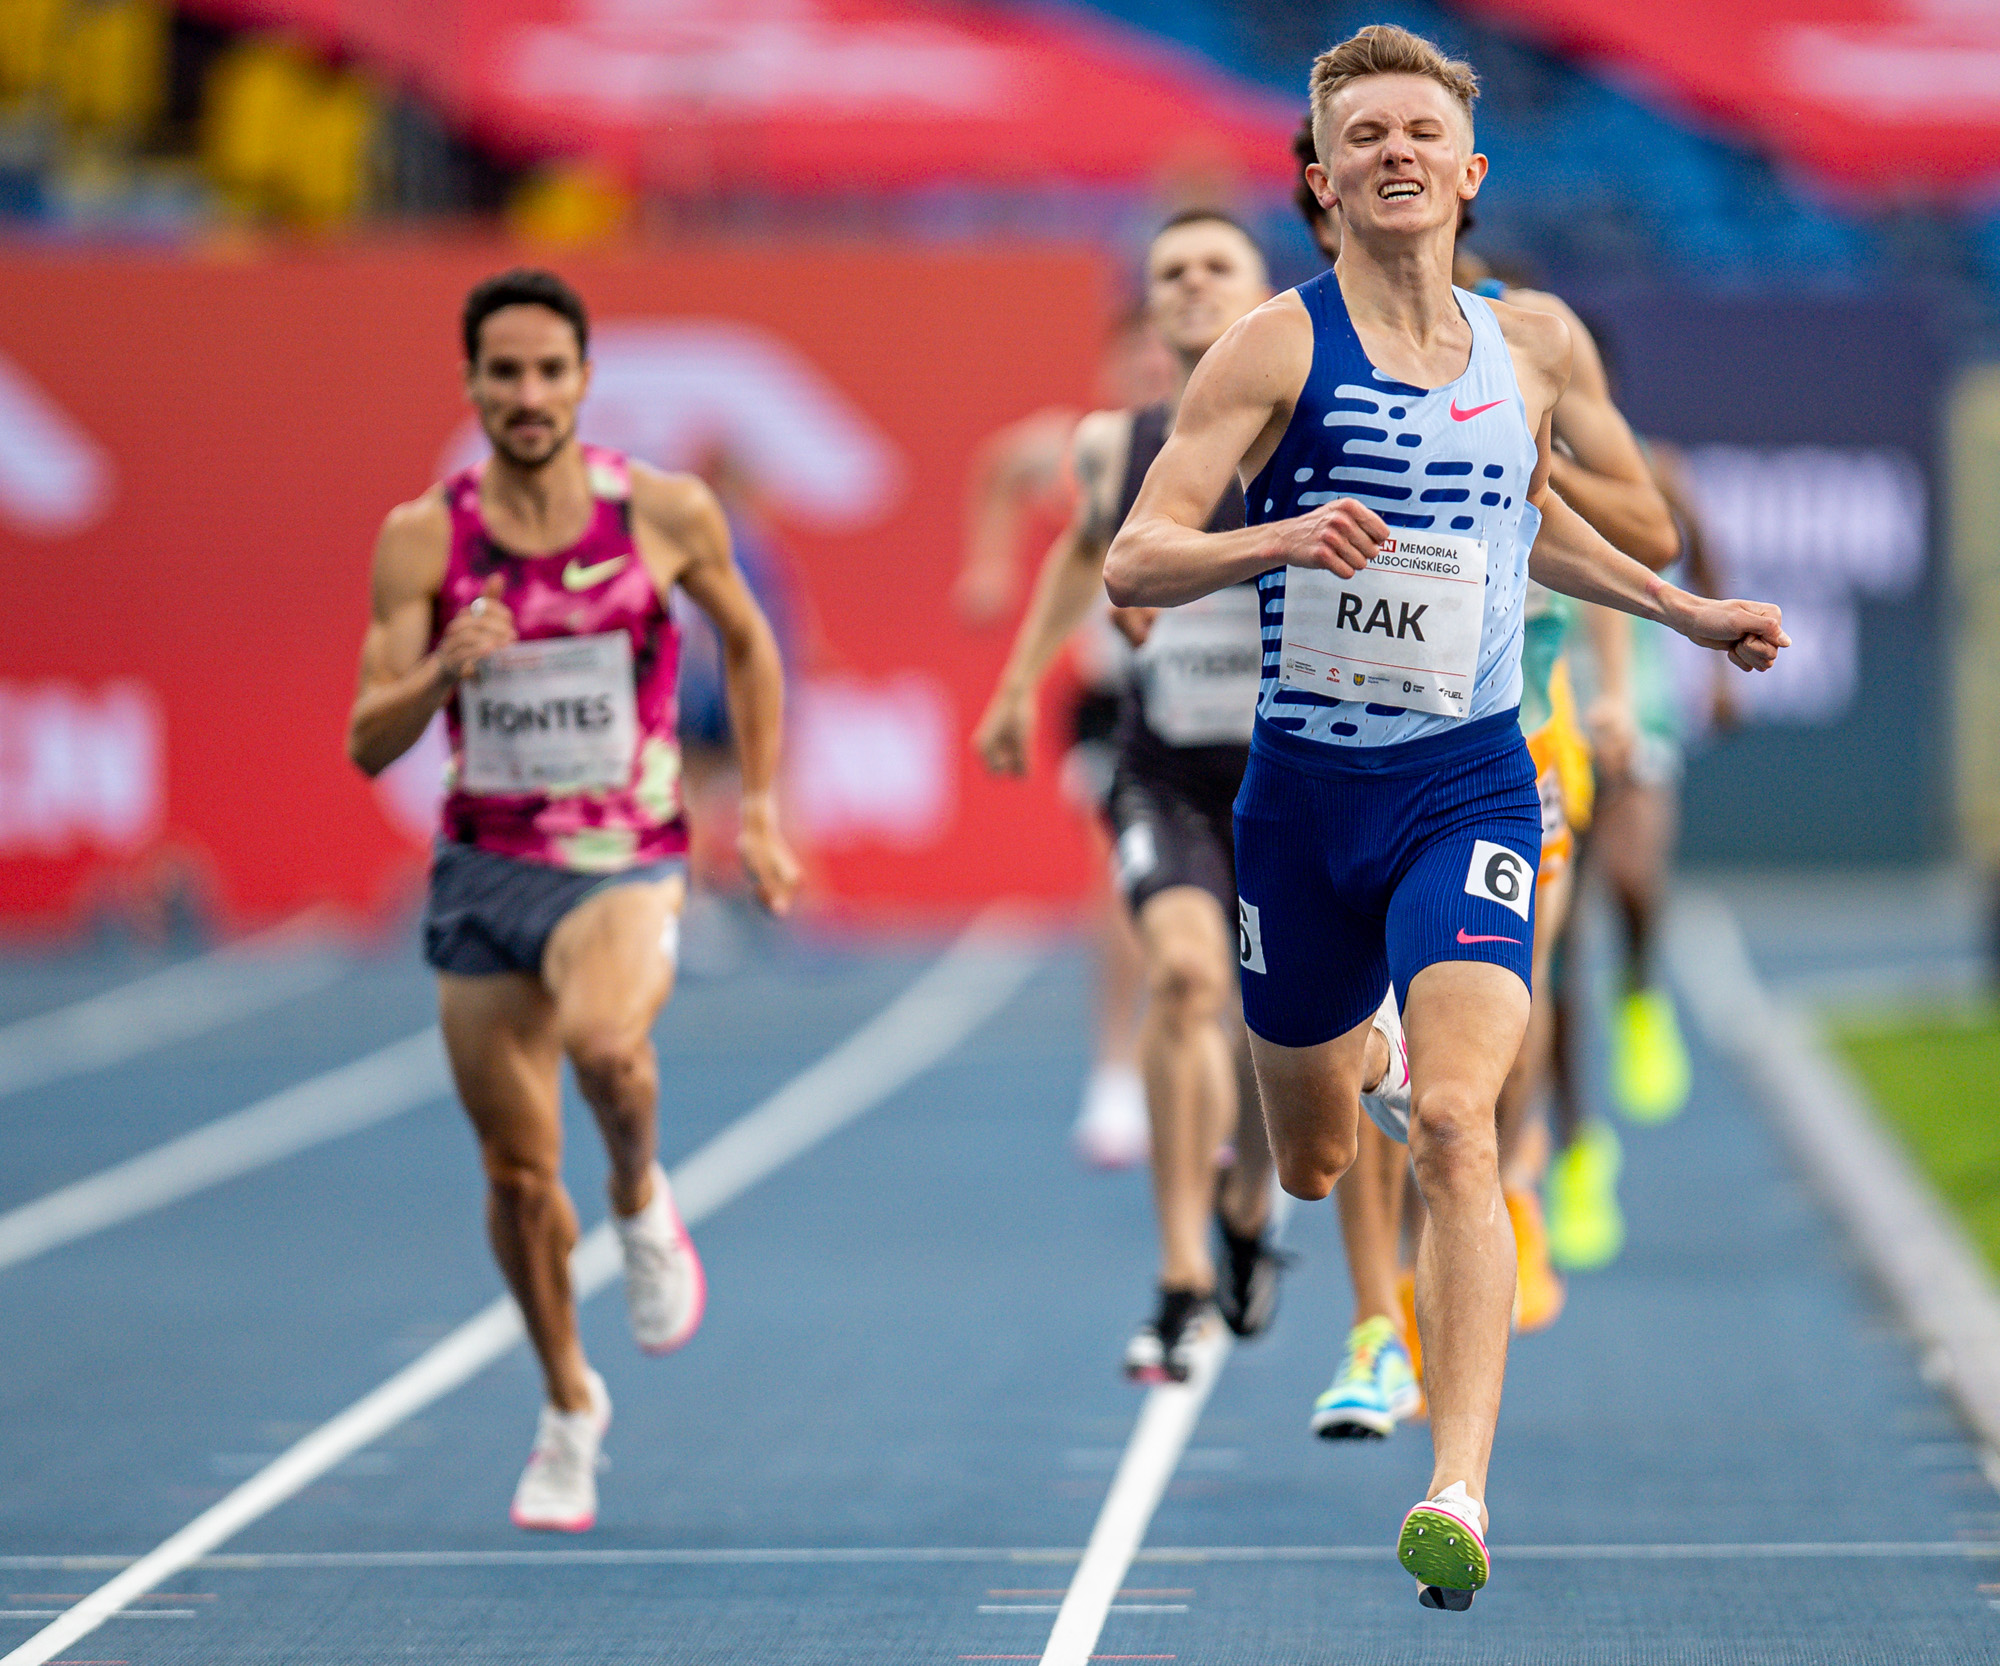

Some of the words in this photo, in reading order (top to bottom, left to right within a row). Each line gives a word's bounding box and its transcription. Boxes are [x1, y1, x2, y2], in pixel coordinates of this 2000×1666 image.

[1400, 542, 1458, 560] MEMORIAŁ
[1336, 591, 1429, 642] RAK
[478, 694, 614, 733] FONTES
[1444, 690, 1463, 699] FUEL
[1484, 852, 1523, 901] 6
